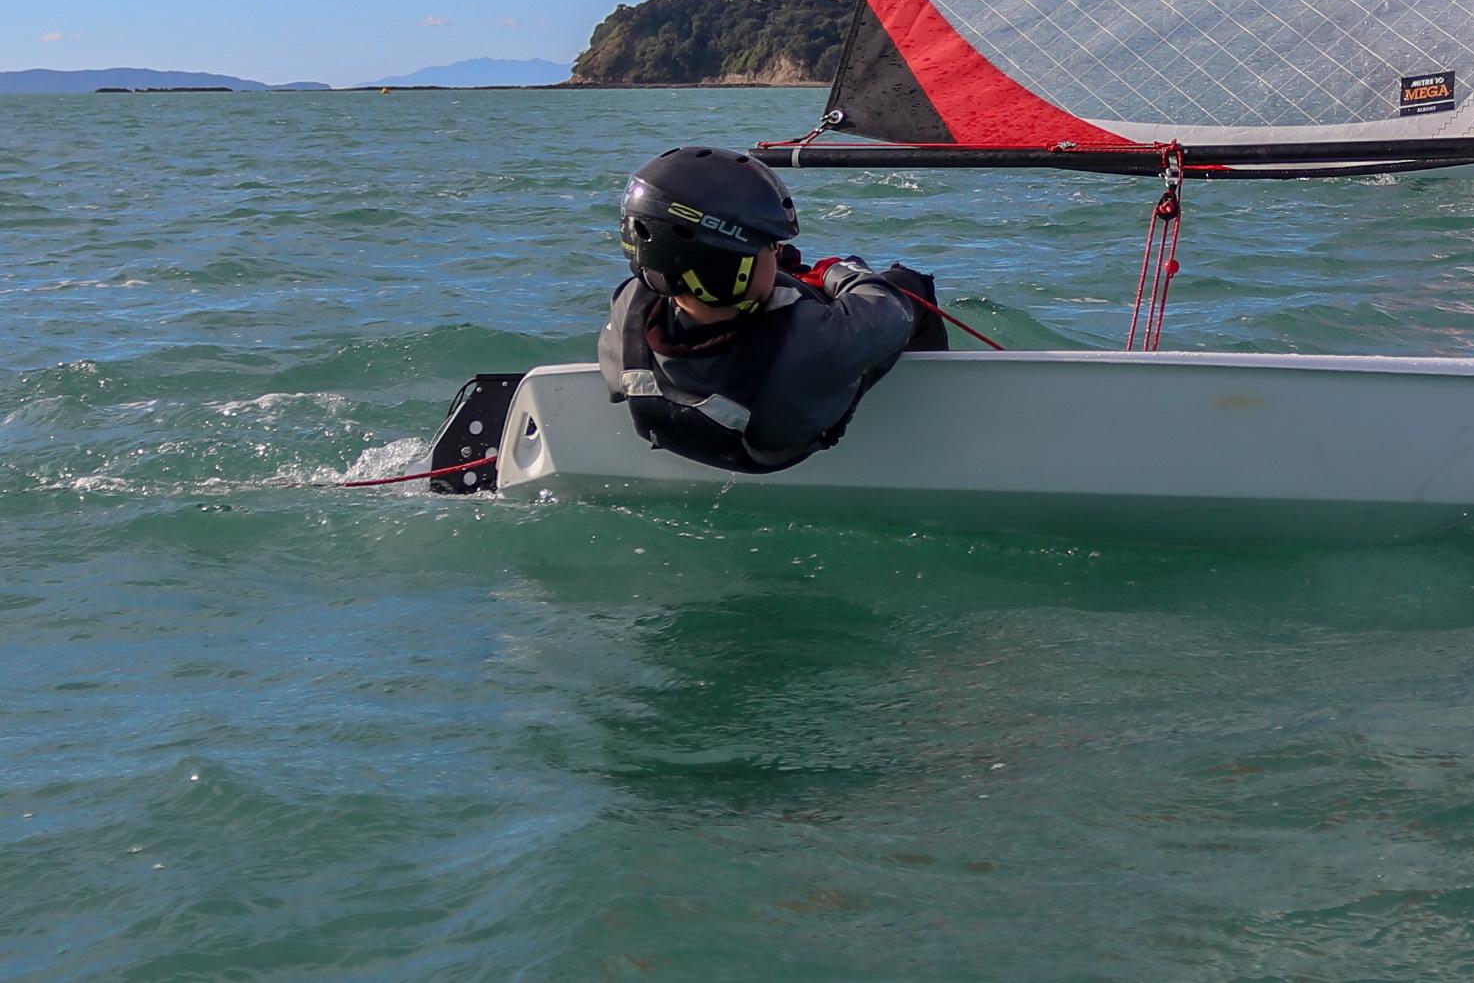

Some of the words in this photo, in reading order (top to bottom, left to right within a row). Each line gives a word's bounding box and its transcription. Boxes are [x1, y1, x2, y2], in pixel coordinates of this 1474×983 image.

[1411, 78, 1434, 88] MITRE
[1435, 76, 1445, 85] 10
[1404, 83, 1450, 101] MEGA
[700, 215, 750, 243] GUL
